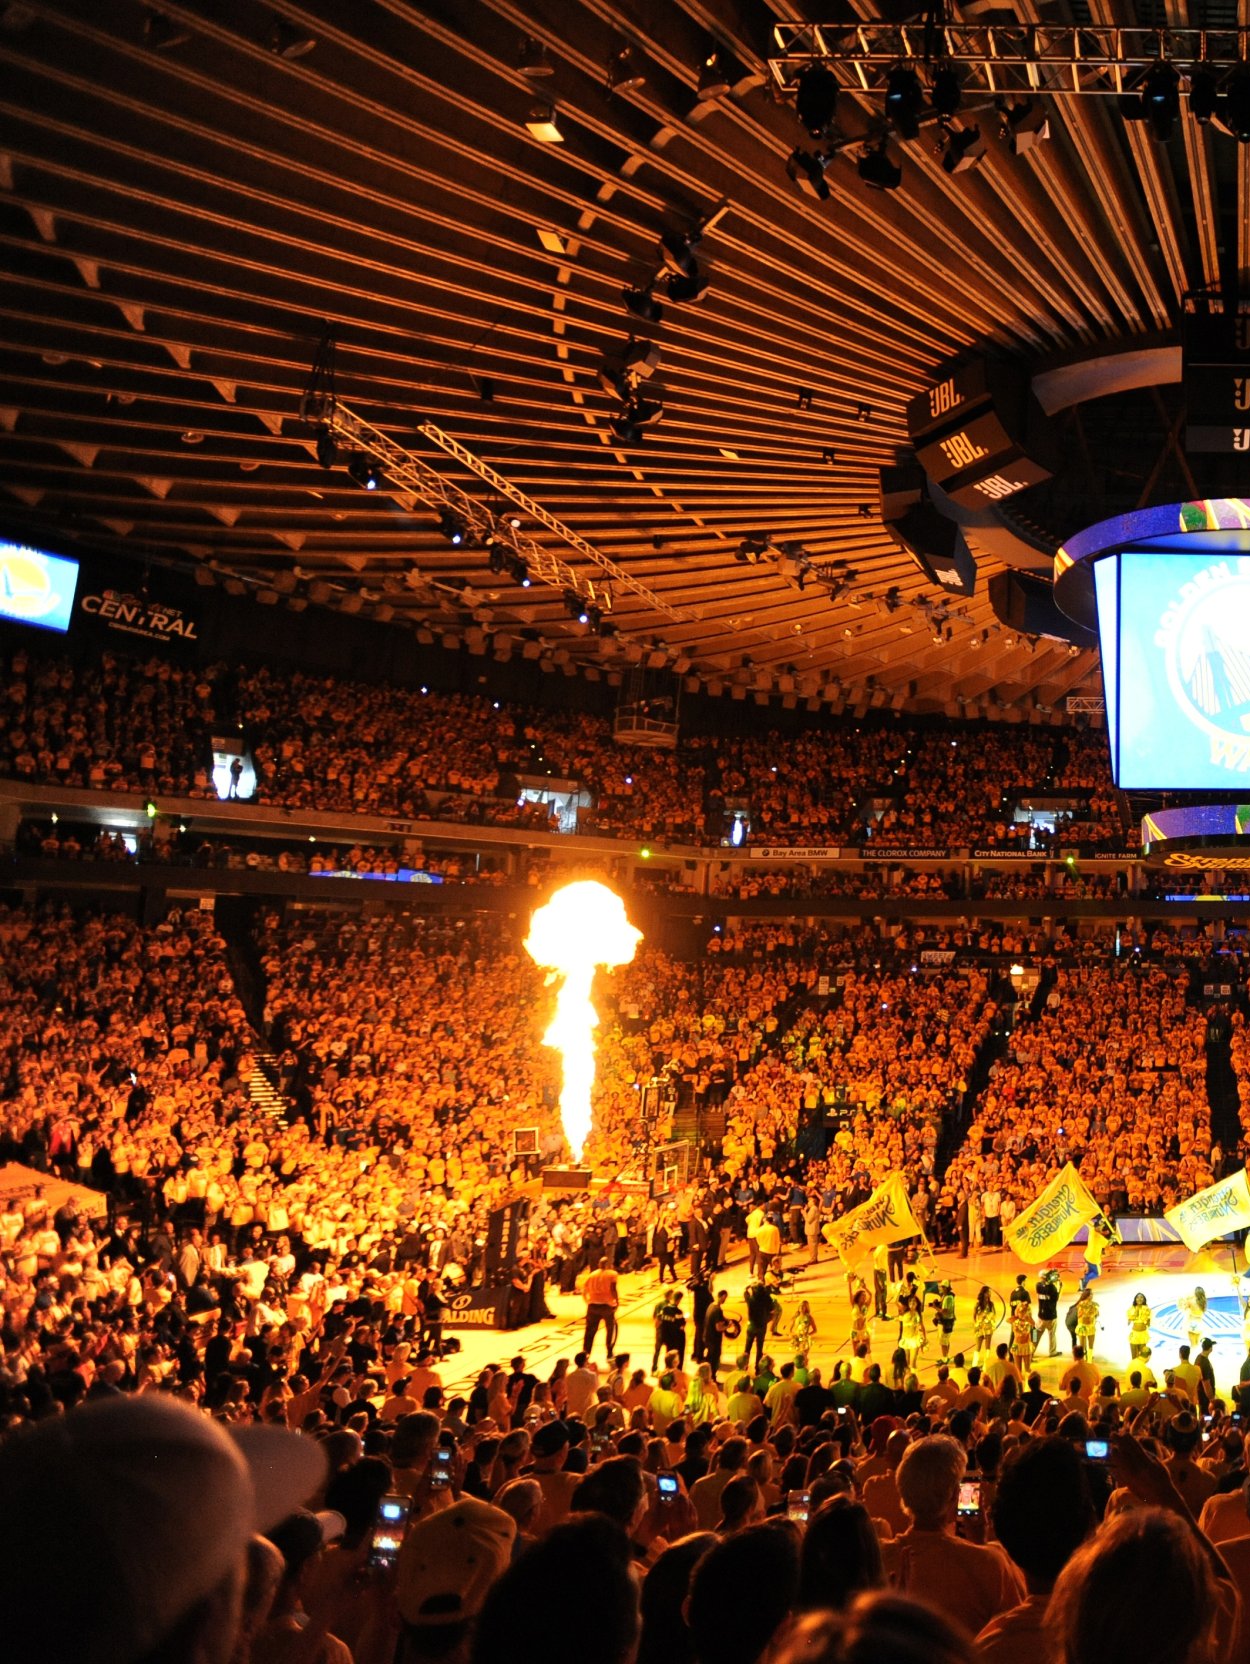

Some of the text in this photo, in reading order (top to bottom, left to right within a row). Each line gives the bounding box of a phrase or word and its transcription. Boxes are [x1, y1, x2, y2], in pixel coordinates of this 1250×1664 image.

[929, 378, 961, 418] JBL
[939, 431, 985, 468] JBL
[973, 474, 1025, 499] JBL
[1153, 561, 1231, 648] GOLDEN
[441, 1307, 496, 1325] ALDING
[518, 1318, 587, 1353] STAT
